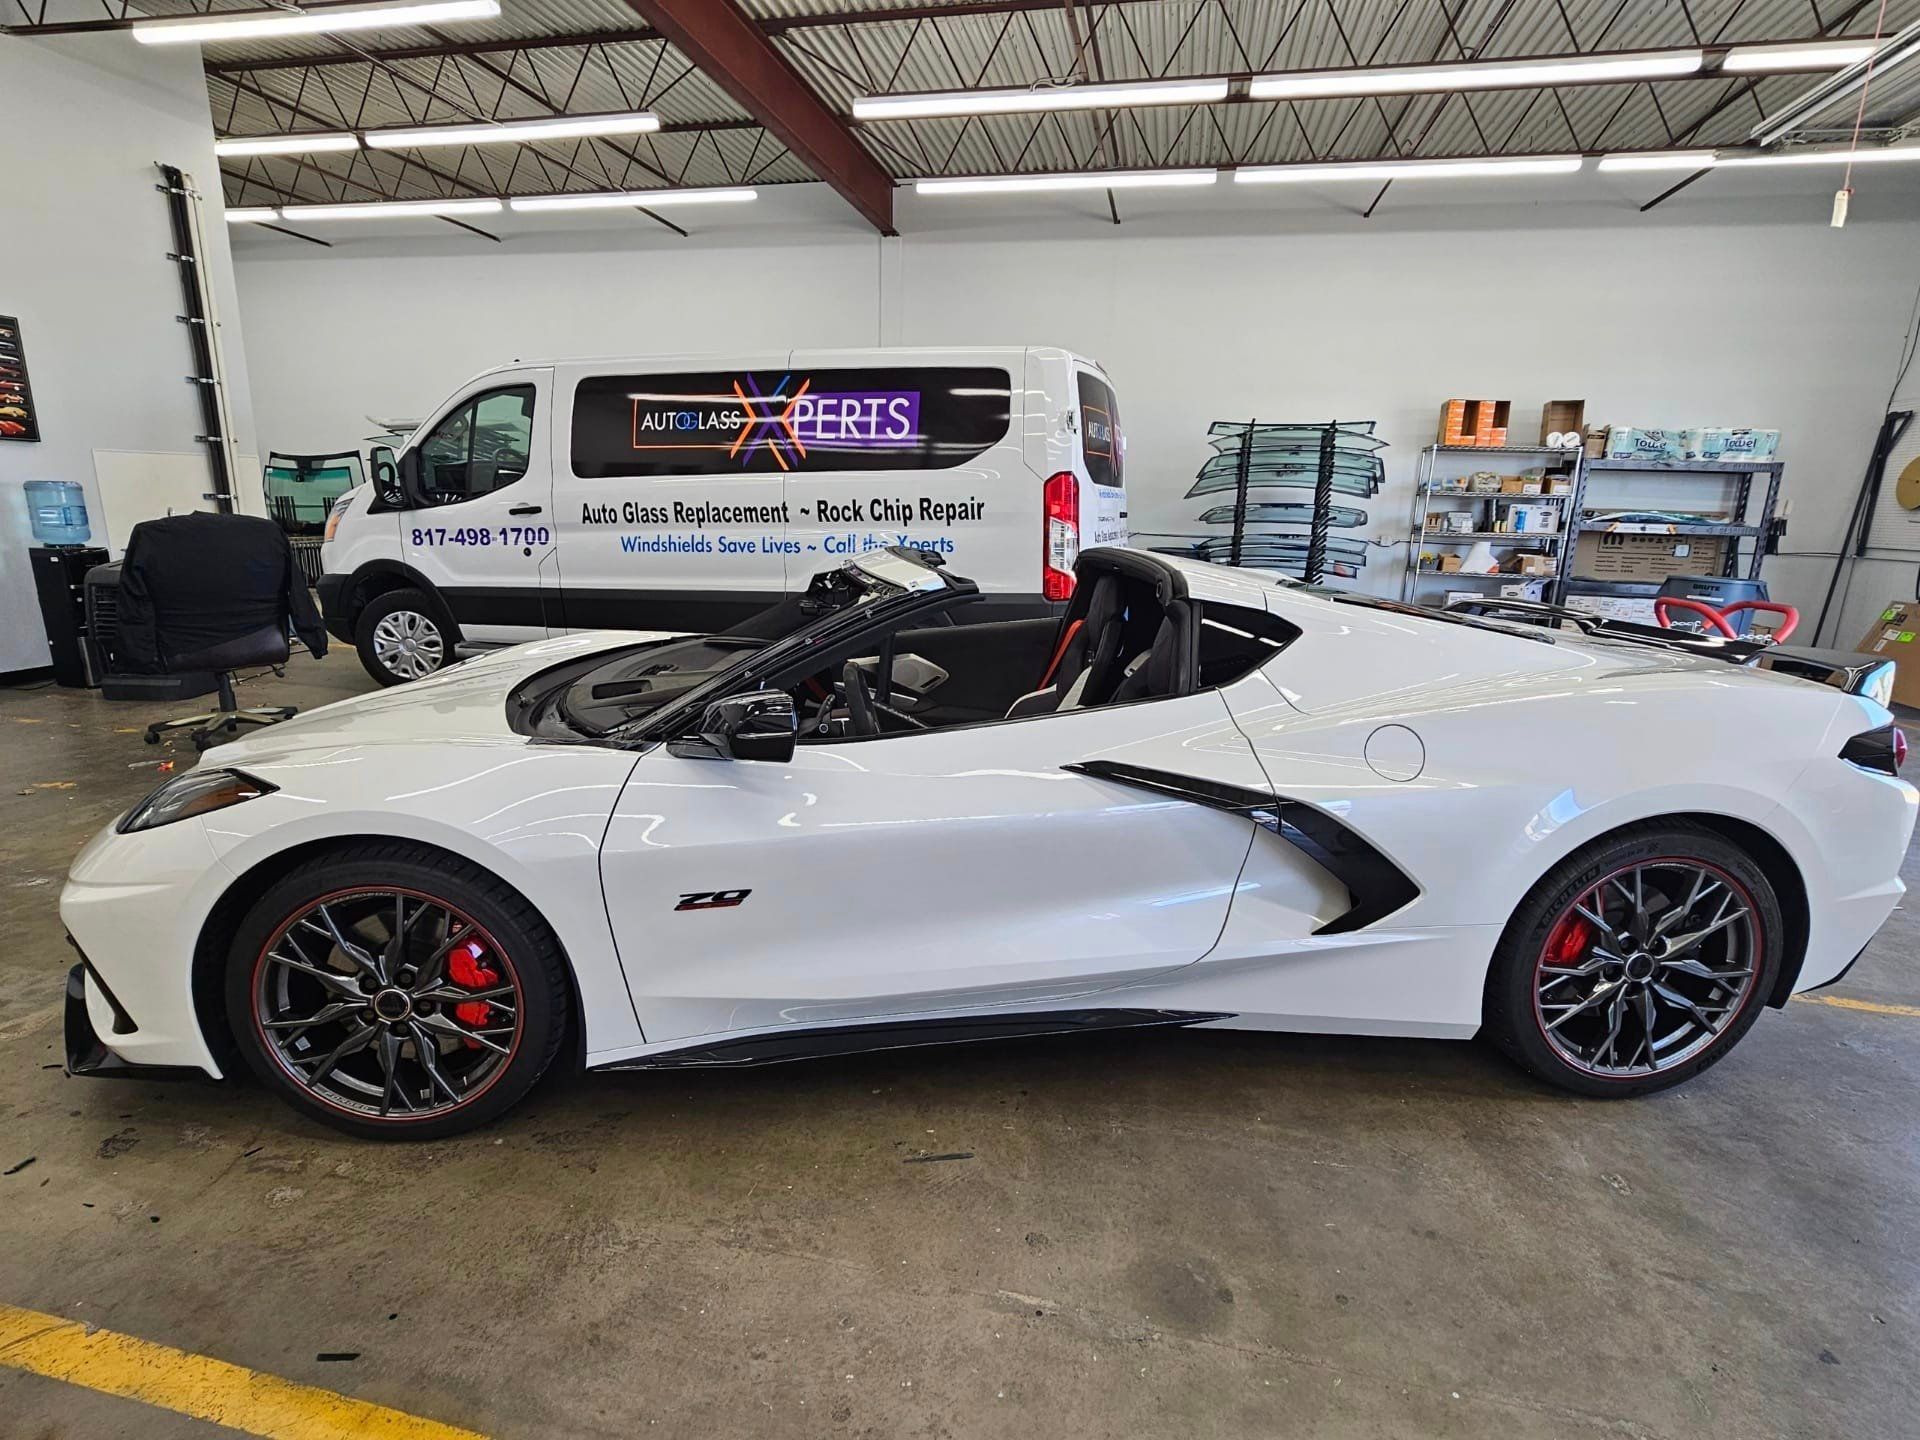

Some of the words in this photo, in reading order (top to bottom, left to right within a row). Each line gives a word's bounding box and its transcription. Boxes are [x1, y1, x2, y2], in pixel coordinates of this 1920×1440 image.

[640, 410, 741, 431] AUTOGLASS
[581, 502, 619, 525] Auto
[622, 501, 669, 524] Glass
[673, 500, 790, 529] Replacement
[816, 499, 865, 523] Rock
[869, 498, 914, 527] Chip
[919, 496, 985, 527] Repair
[412, 526, 550, 547] 817-498-1700
[620, 534, 713, 553] Windshields
[718, 535, 757, 553] Save
[762, 535, 801, 554] Lives
[823, 534, 856, 554] Call
[896, 535, 955, 553] Xperts
